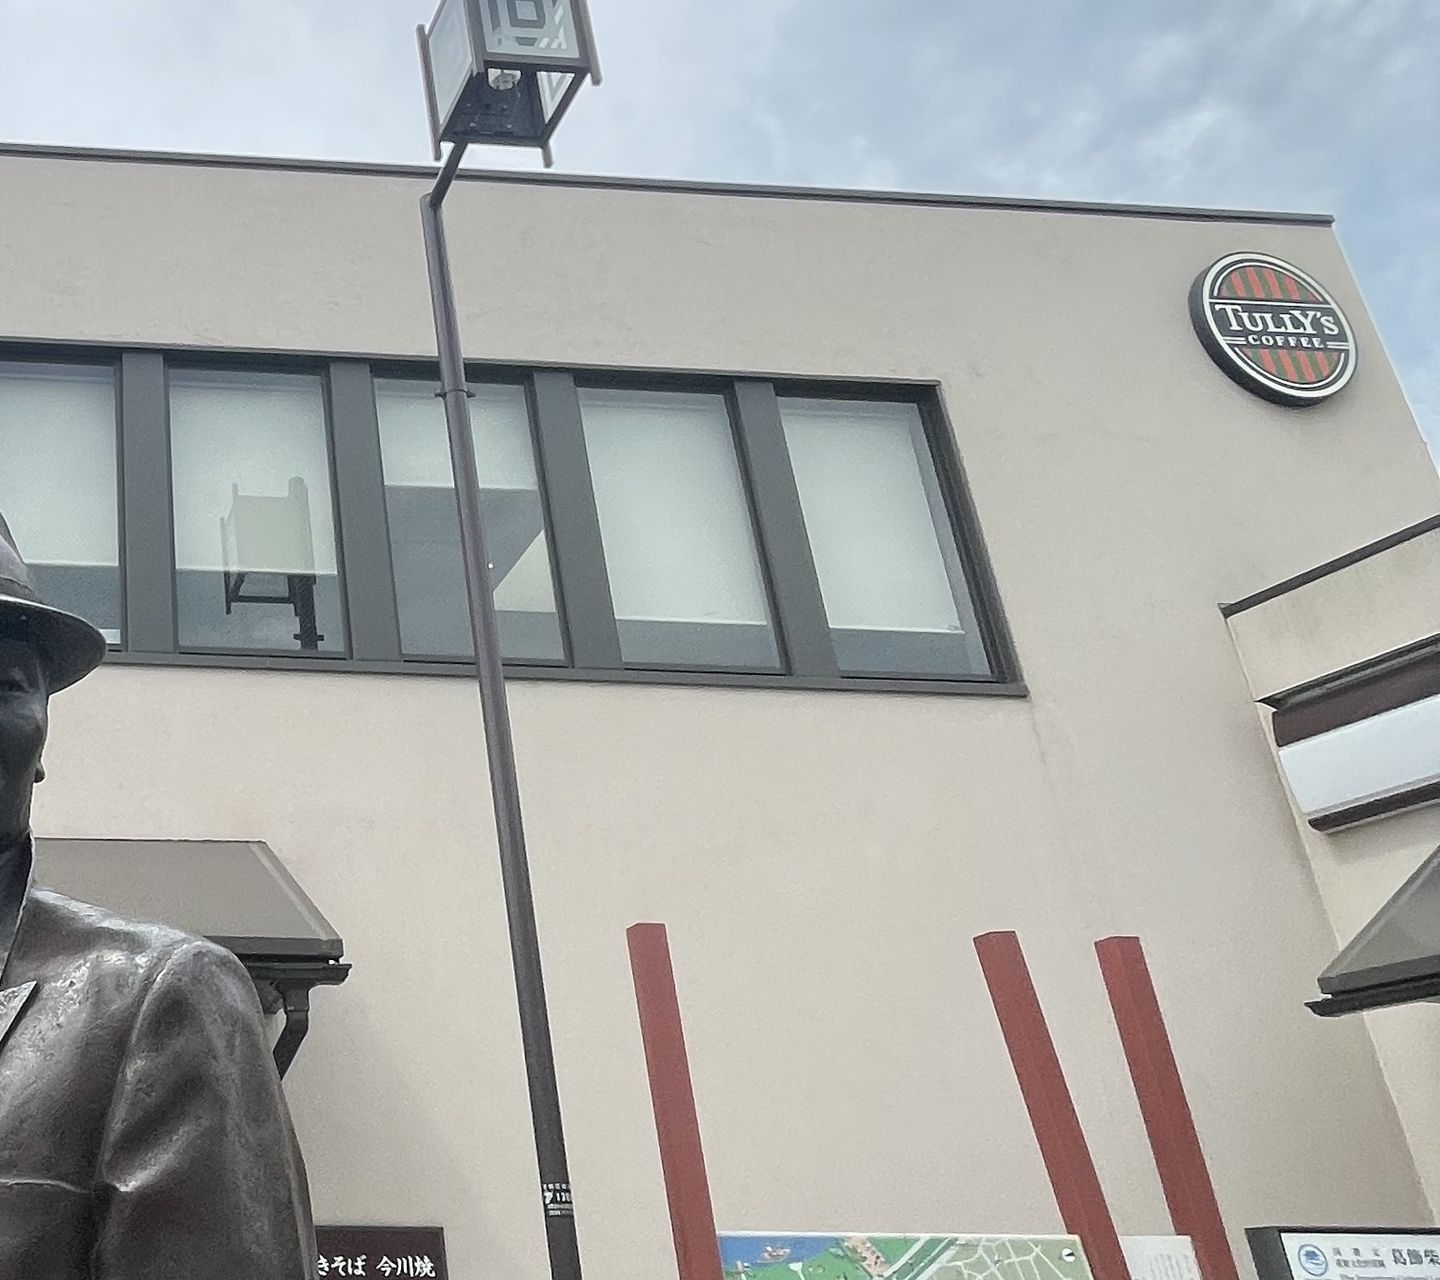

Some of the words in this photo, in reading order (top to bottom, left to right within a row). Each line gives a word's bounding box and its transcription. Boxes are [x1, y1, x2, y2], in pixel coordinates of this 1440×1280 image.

[1215, 303, 1339, 335] TULLY'S
[1247, 334, 1325, 349] COFFEE
[376, 1255, 436, 1278] 今川焼
